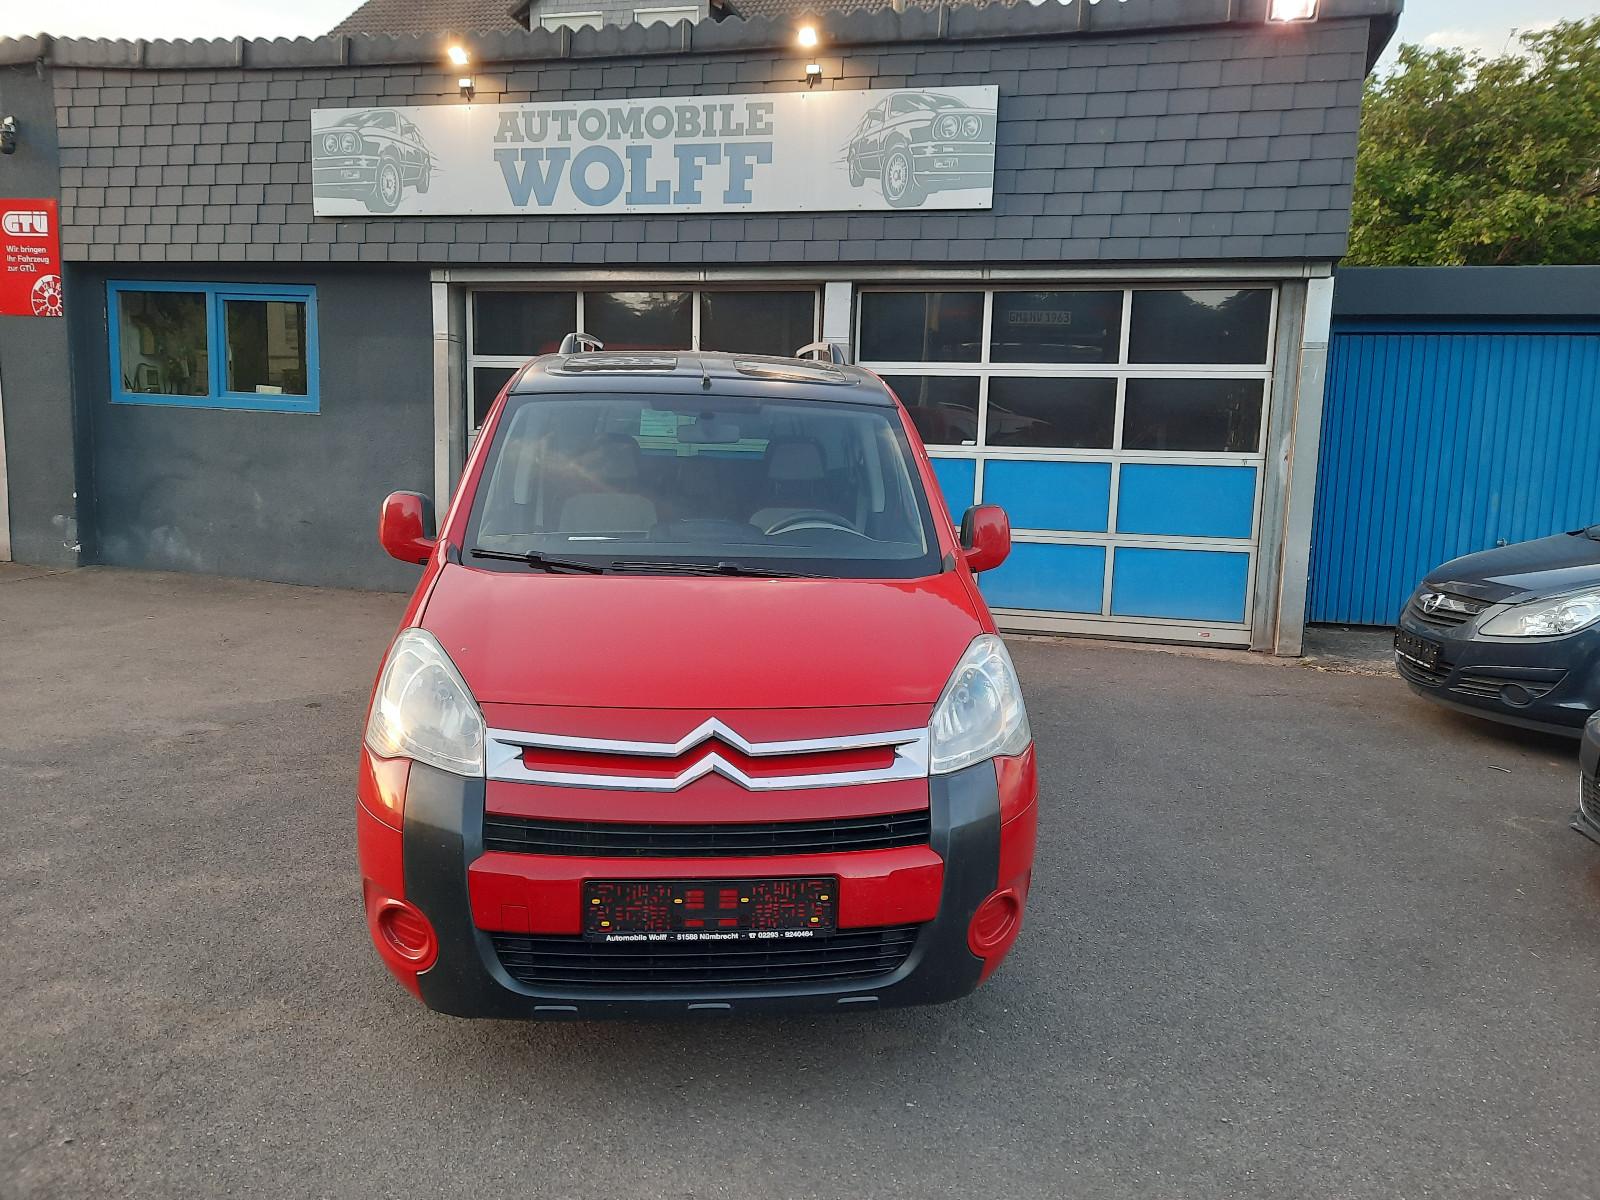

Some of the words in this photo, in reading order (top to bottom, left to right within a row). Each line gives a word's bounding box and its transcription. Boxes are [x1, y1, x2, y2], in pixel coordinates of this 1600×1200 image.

[493, 102, 774, 143] AUTOMOBILE
[493, 142, 773, 206] WOLFF
[3, 211, 48, 235] GTÜ
[20, 245, 47, 254] bringen
[17, 255, 50, 265] Fahrzeug
[606, 934, 648, 942] Automobile
[648, 933, 668, 941] Wolff
[677, 933, 698, 941] 51588
[699, 933, 739, 941] Nümbrecht
